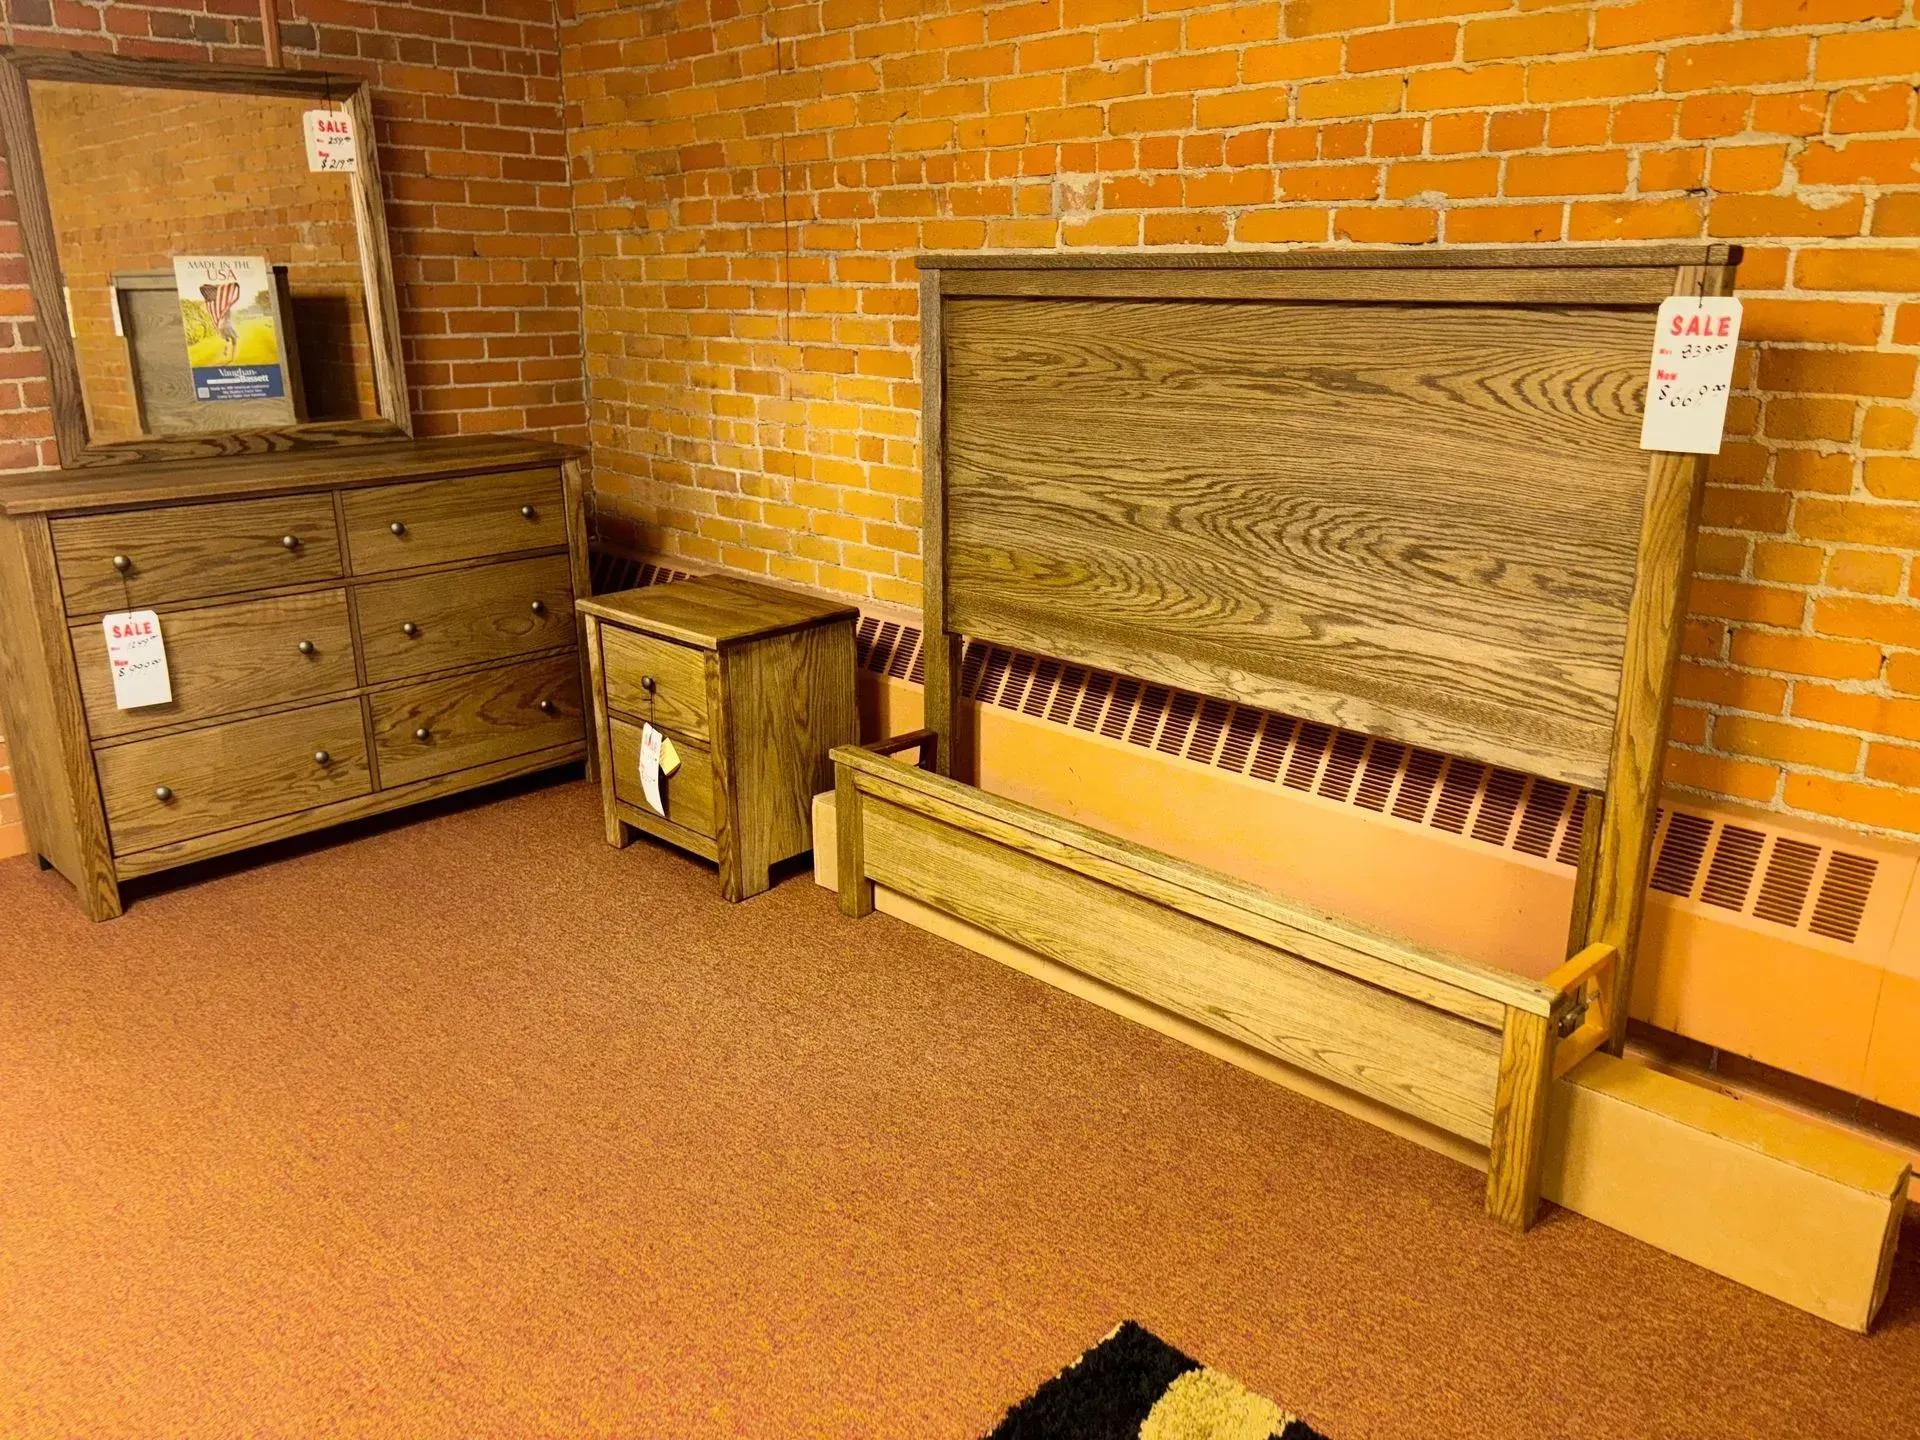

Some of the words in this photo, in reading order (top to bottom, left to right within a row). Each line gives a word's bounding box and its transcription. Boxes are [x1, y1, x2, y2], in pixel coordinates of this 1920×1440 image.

[318, 119, 348, 134] SALE
[187, 260, 217, 269] MADE
[219, 260, 231, 269] IN
[234, 260, 253, 269] THE
[206, 268, 238, 281] USA
[1670, 313, 1732, 337] SALE
[1656, 369, 1678, 382] Now
[112, 621, 153, 639] SALE
